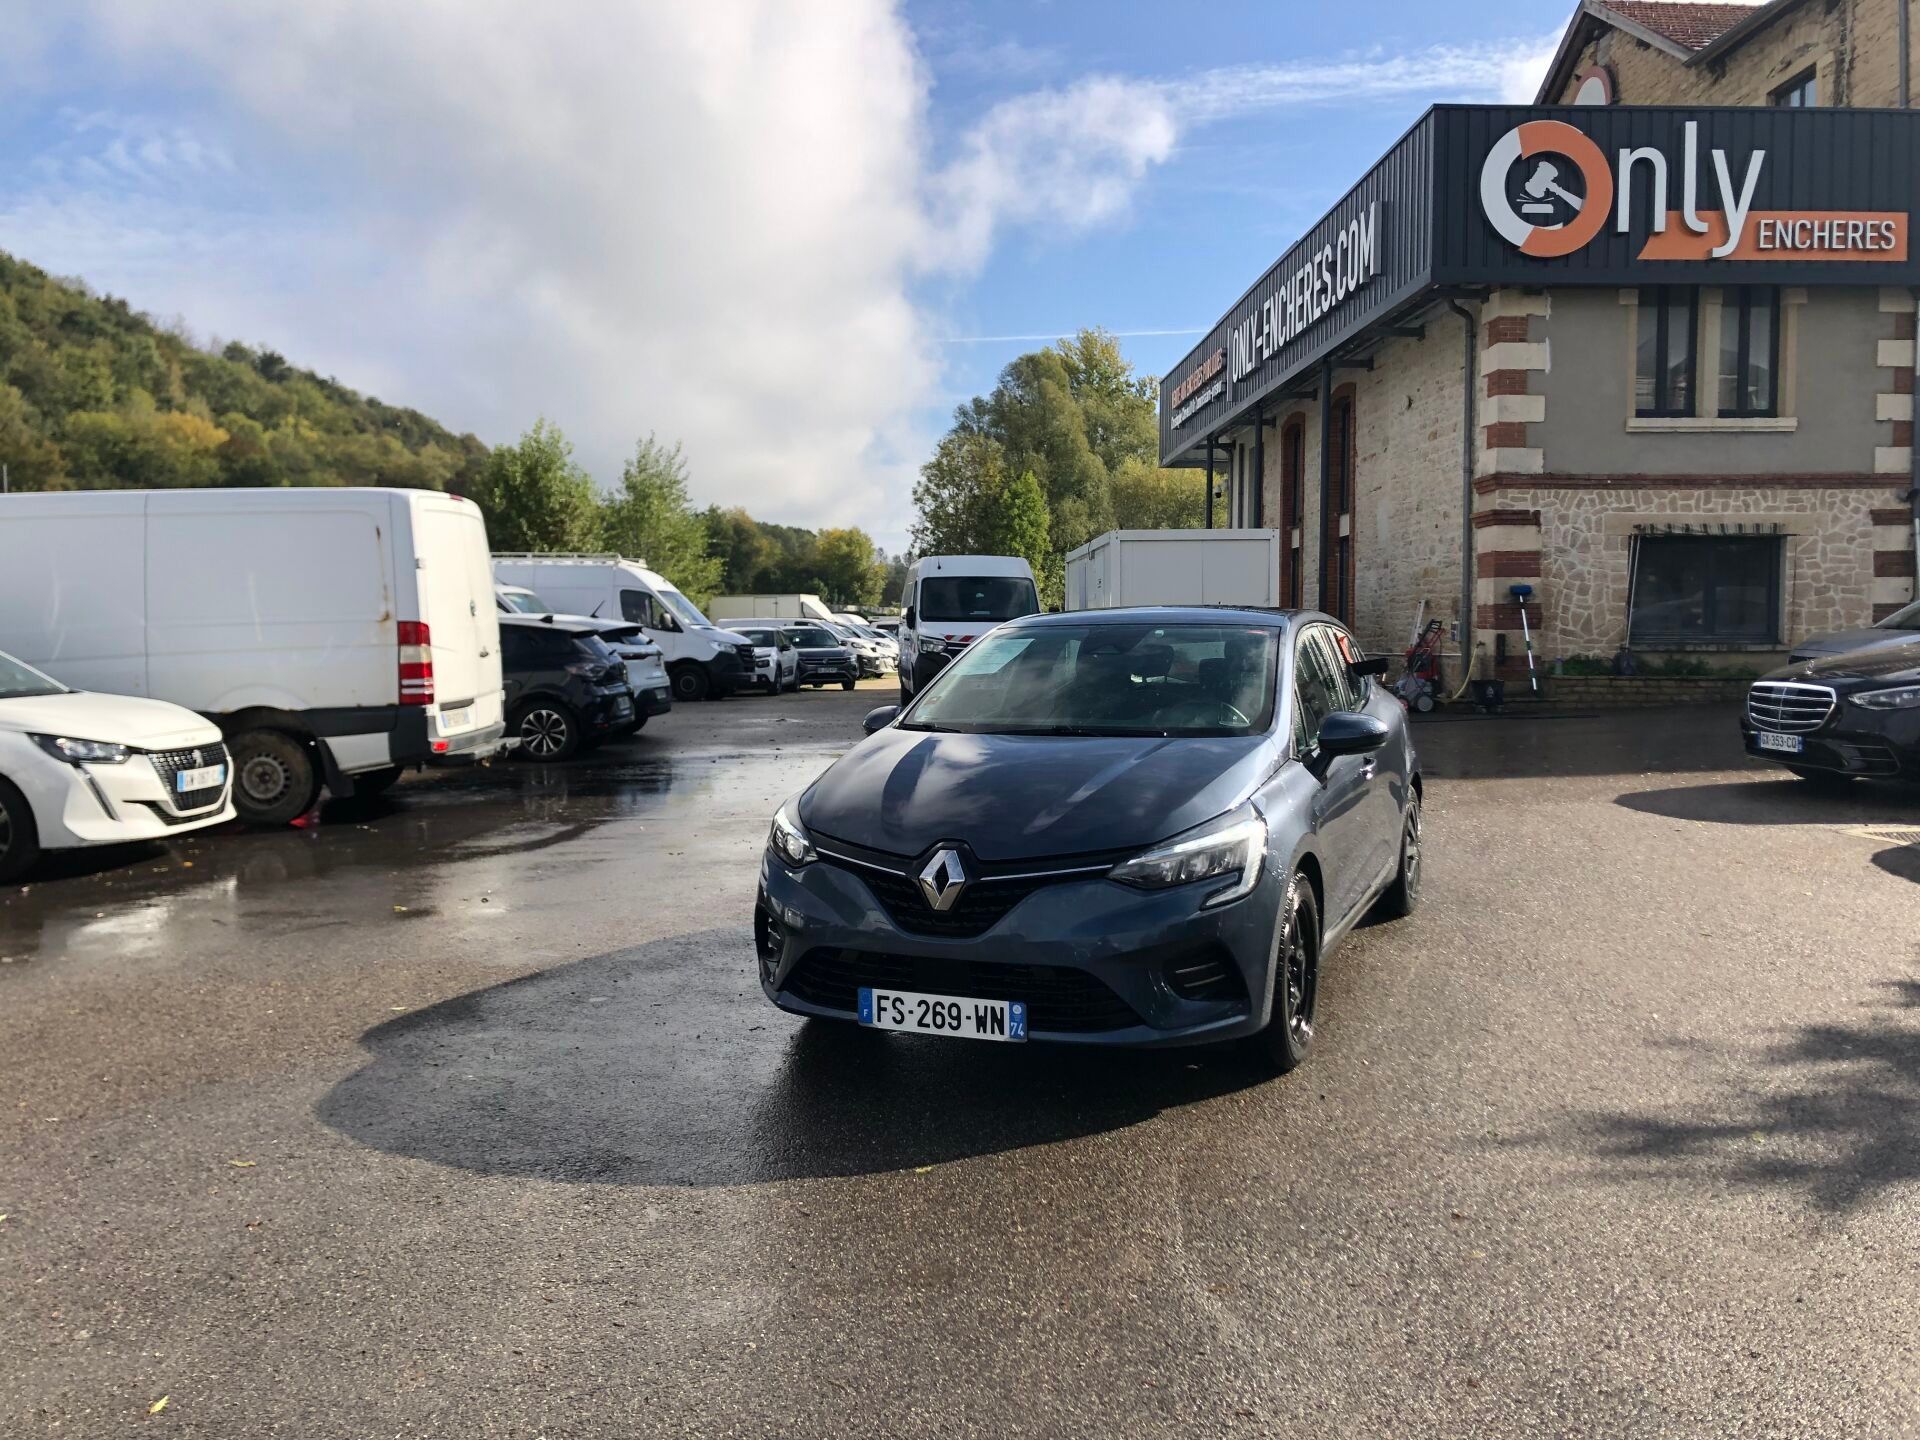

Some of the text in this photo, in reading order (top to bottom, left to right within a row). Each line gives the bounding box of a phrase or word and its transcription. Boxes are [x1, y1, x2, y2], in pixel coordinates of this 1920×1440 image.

[1480, 120, 1766, 258] Only
[1759, 219, 1896, 250] ENCHERES
[1232, 200, 1375, 383] ONLY-ENCHERES.COM
[876, 994, 1005, 1036] FS-269-WN
[1010, 1022, 1025, 1037] 74
